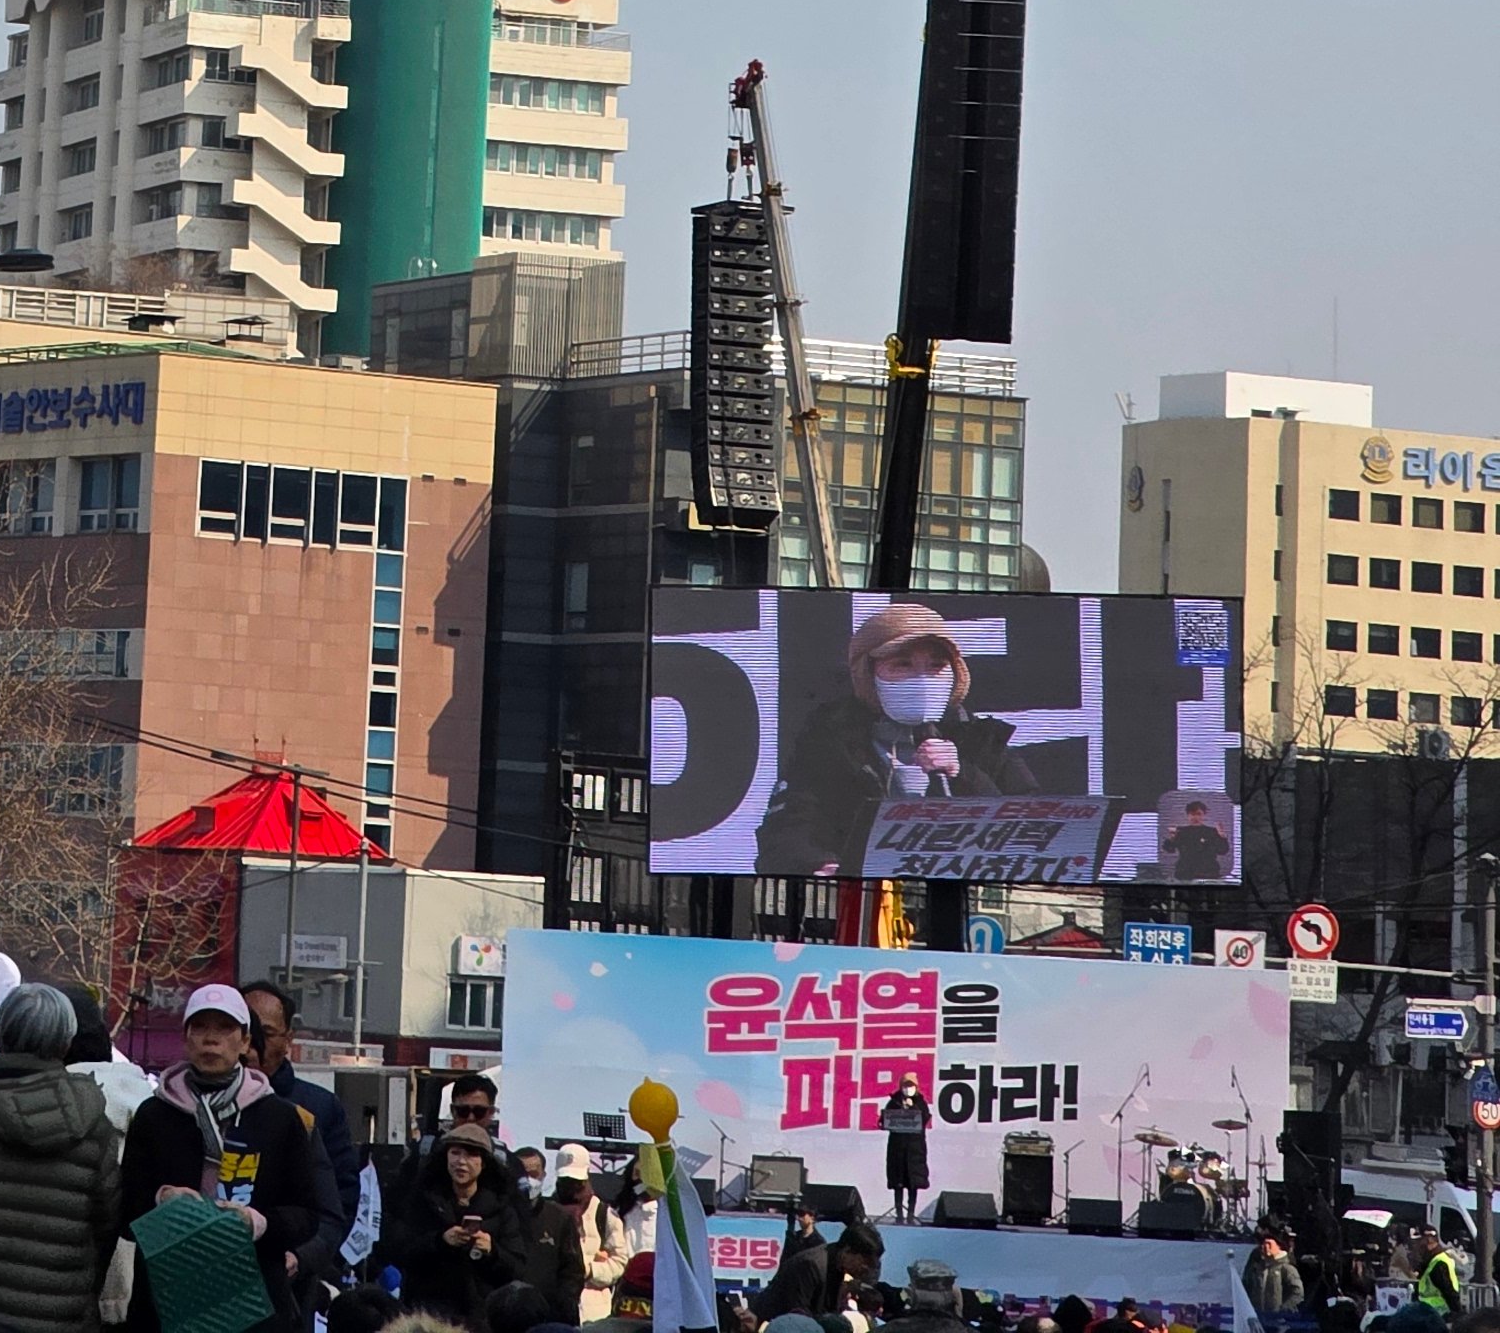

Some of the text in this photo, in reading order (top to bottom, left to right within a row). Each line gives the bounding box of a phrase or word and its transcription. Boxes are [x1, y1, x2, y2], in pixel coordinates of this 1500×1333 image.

[875, 821, 1065, 852] 내란세력
[1129, 928, 1187, 950] 좌회전후
[1232, 945, 1250, 960] 40
[706, 970, 1000, 1053] 윤석열을
[780, 1052, 1080, 1131] 파면하라!
[1481, 1103, 1499, 1120] 50
